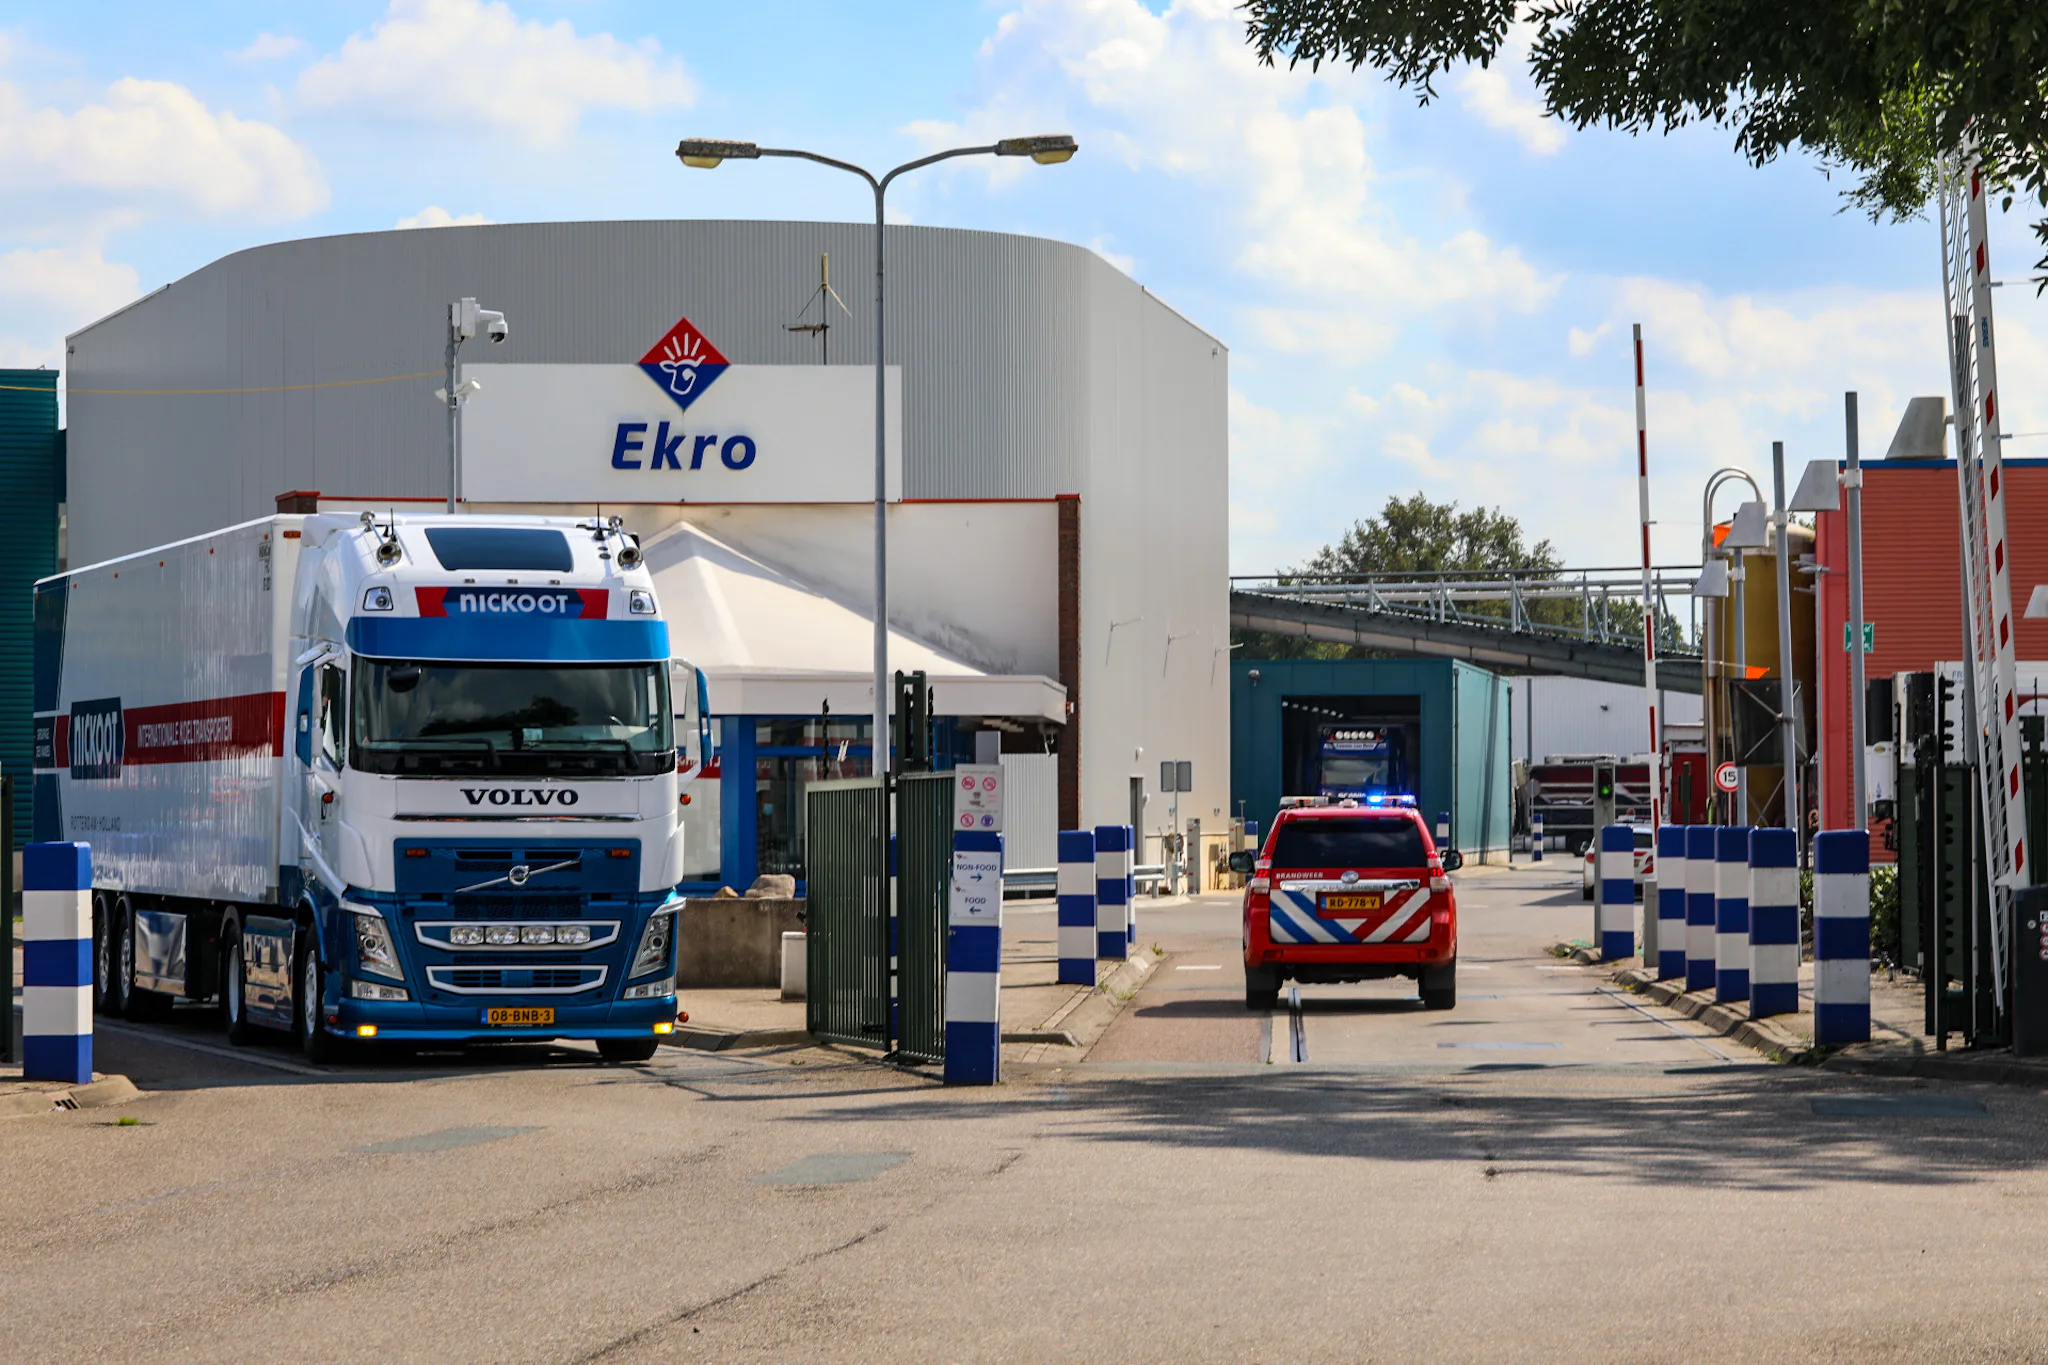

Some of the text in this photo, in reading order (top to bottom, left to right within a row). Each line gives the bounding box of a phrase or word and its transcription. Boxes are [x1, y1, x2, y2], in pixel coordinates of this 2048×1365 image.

[611, 421, 757, 470] Ekro
[1723, 771, 1737, 782] 15
[460, 788, 579, 806] VOLVO
[956, 863, 997, 871] NON-FOOD
[491, 1010, 551, 1022] 08-BNB-3
